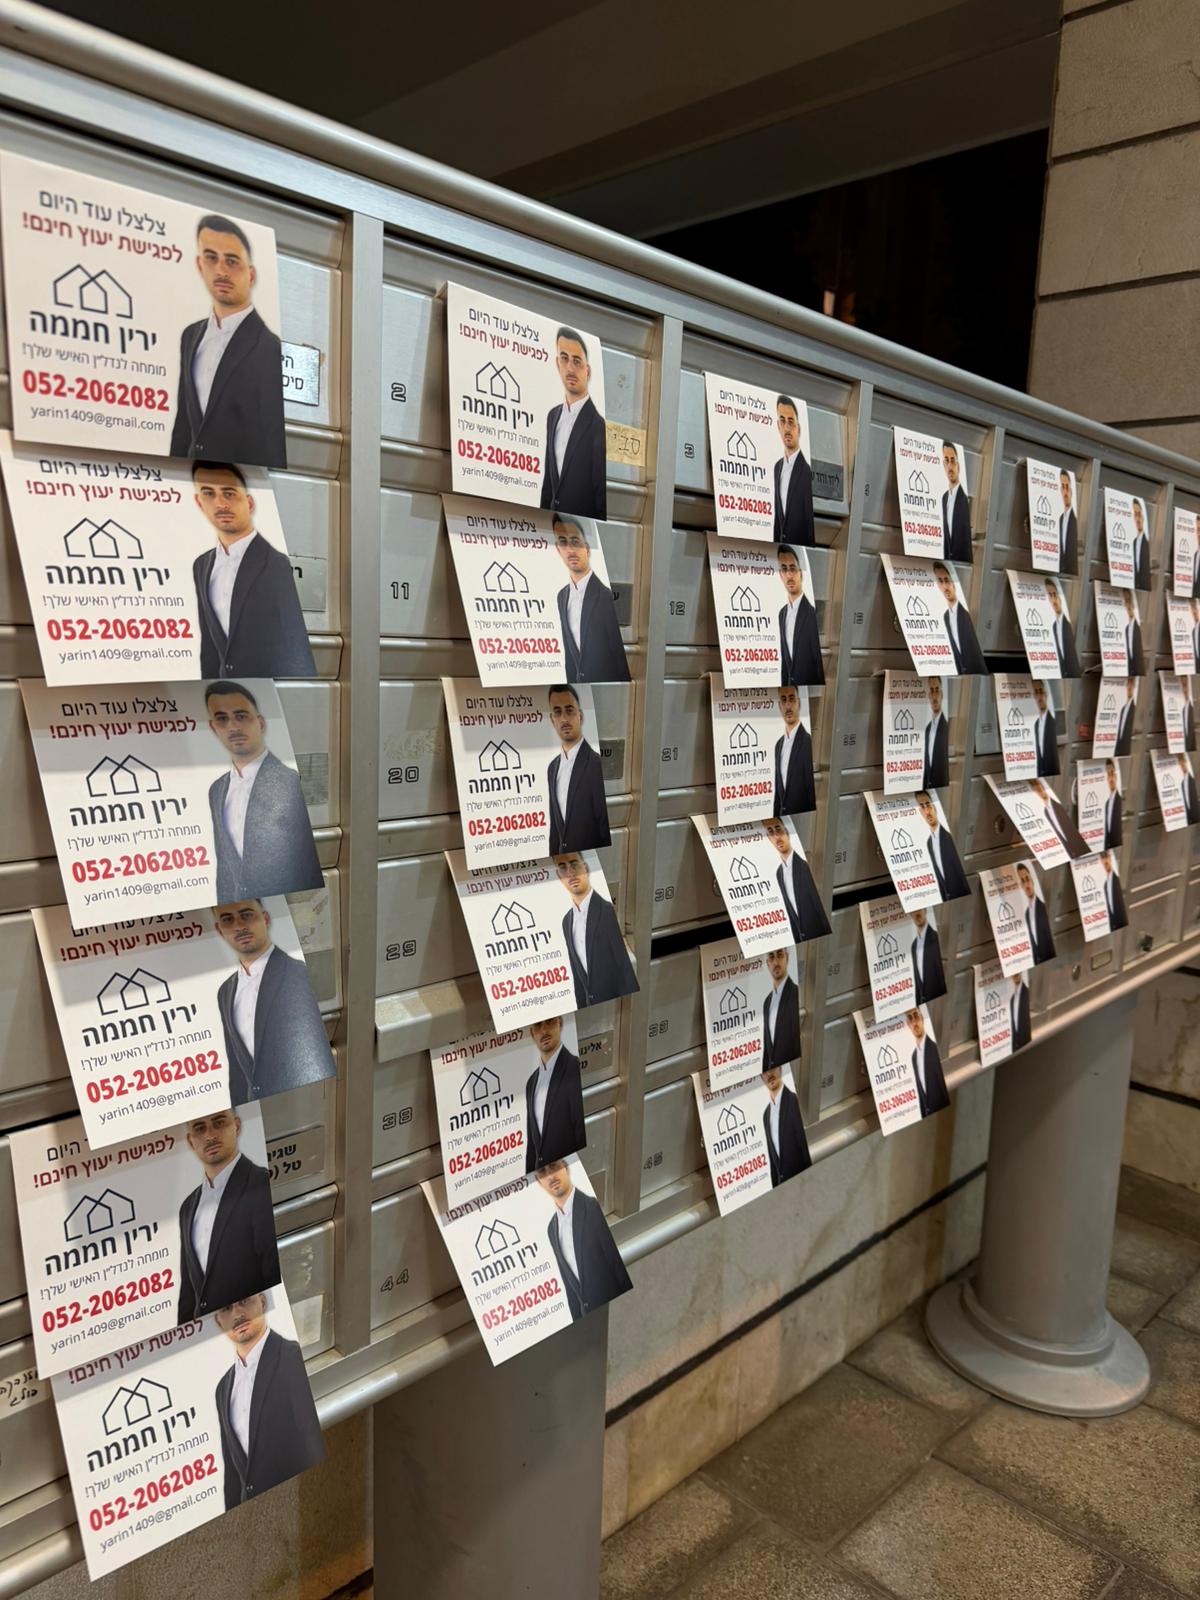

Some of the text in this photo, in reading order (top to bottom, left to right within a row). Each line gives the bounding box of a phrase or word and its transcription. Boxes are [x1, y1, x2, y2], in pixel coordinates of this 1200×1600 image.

[39, 190, 166, 236] צלצלו עוד היום
[22, 211, 183, 263] לפגישת יעוץ חינם!
[30, 310, 157, 354] ירין חממה
[468, 307, 539, 342] צלצלו עוד היום
[489, 333, 509, 349] יעוץ
[511, 341, 549, 362] לפגישת
[22, 369, 169, 412] 052-2062082
[391, 382, 406, 403] 2
[30, 406, 165, 431] yarin1409@gmail.com
[462, 395, 534, 429] ירין חממה
[458, 438, 541, 474] 052-2062082
[684, 442, 695, 459] 3
[38, 459, 163, 482] צלצלו עוד היום
[462, 467, 538, 489] yarin1409@gmail.com
[719, 459, 766, 482] ירין חממה
[26, 479, 182, 503] לפגישת יעוץ חינם!
[719, 493, 773, 515] 052-2062082
[465, 515, 537, 533] צלצלו עוד היום
[489, 534, 509, 549] יעוץ
[512, 536, 548, 549] לפגישת
[45, 565, 170, 592] ירין חממה
[390, 581, 409, 600] 11
[474, 597, 545, 618] ירין חממה
[670, 600, 685, 616] 12
[46, 618, 193, 641] 052-2062082
[724, 615, 770, 632] ירין חממה
[58, 647, 192, 664] yarin1409@gmail.com
[478, 637, 560, 654] 052-2062082
[725, 648, 779, 662] 052-2062082
[486, 659, 561, 672] yarin1409@gmail.com
[61, 696, 178, 716] צלצלו עוד היום
[465, 694, 533, 709] צלצלו עוד היום
[49, 716, 196, 740] לפגישת יעוץ חינם!
[486, 714, 506, 728] יעוץ
[508, 710, 543, 724] לפגישת
[722, 750, 767, 767] ירין חממה
[388, 766, 419, 784] 20
[468, 773, 535, 794] ירין חממה
[720, 780, 773, 800] 052-2062082
[69, 797, 187, 826] ירין חממה
[468, 810, 547, 837] 052-2062082
[474, 834, 546, 854] yarin1409@gmail.com
[71, 845, 210, 883] 052-2062082
[494, 877, 513, 892] יעוץ
[515, 869, 549, 886] לפגישת
[727, 880, 771, 899] ירין חממה
[83, 876, 209, 906] yarin1409@gmail.com
[736, 908, 787, 932] 052-2062082
[60, 922, 203, 962] לפגישת יעוץ חינם!
[386, 939, 417, 961] 29
[484, 929, 551, 958] ירין חממה
[491, 965, 570, 1000] 052-2062082
[500, 988, 571, 1017] yarin1409@gmail.com
[81, 1003, 197, 1047] ירין חממה
[713, 1009, 756, 1034] ירין חממה
[712, 1038, 762, 1067] 052-2062082
[86, 1050, 222, 1103] 052-2062082
[98, 1080, 222, 1126] yarin1409@gmail.com
[449, 1093, 514, 1131] ירין חממה
[382, 1106, 413, 1131] 38
[712, 1132, 741, 1155] חממה
[742, 1124, 756, 1145] ירין
[33, 1135, 175, 1188] לפגישת יעוץ חינם!
[448, 1130, 524, 1175] 052-2062082
[454, 1153, 522, 1191] yarin1409@gmail.com
[716, 1153, 768, 1189] 052-2062082
[45, 1221, 158, 1276] ירין חממה
[471, 1242, 538, 1287] ירין חממה
[380, 1268, 409, 1292] 44
[42, 1268, 174, 1333] 052-2062082
[482, 1277, 562, 1330] 052-2062082
[51, 1299, 172, 1355] yarin1409@gmail.com
[149, 1317, 204, 1352] לפגישת
[494, 1301, 565, 1346] yarin1409@gmail.com
[113, 1342, 144, 1369] יעוץ
[86, 1406, 196, 1472] ירין חממה
[89, 1453, 218, 1532] 052-2062082
[100, 1485, 217, 1554] yarin1409@gmail.com
